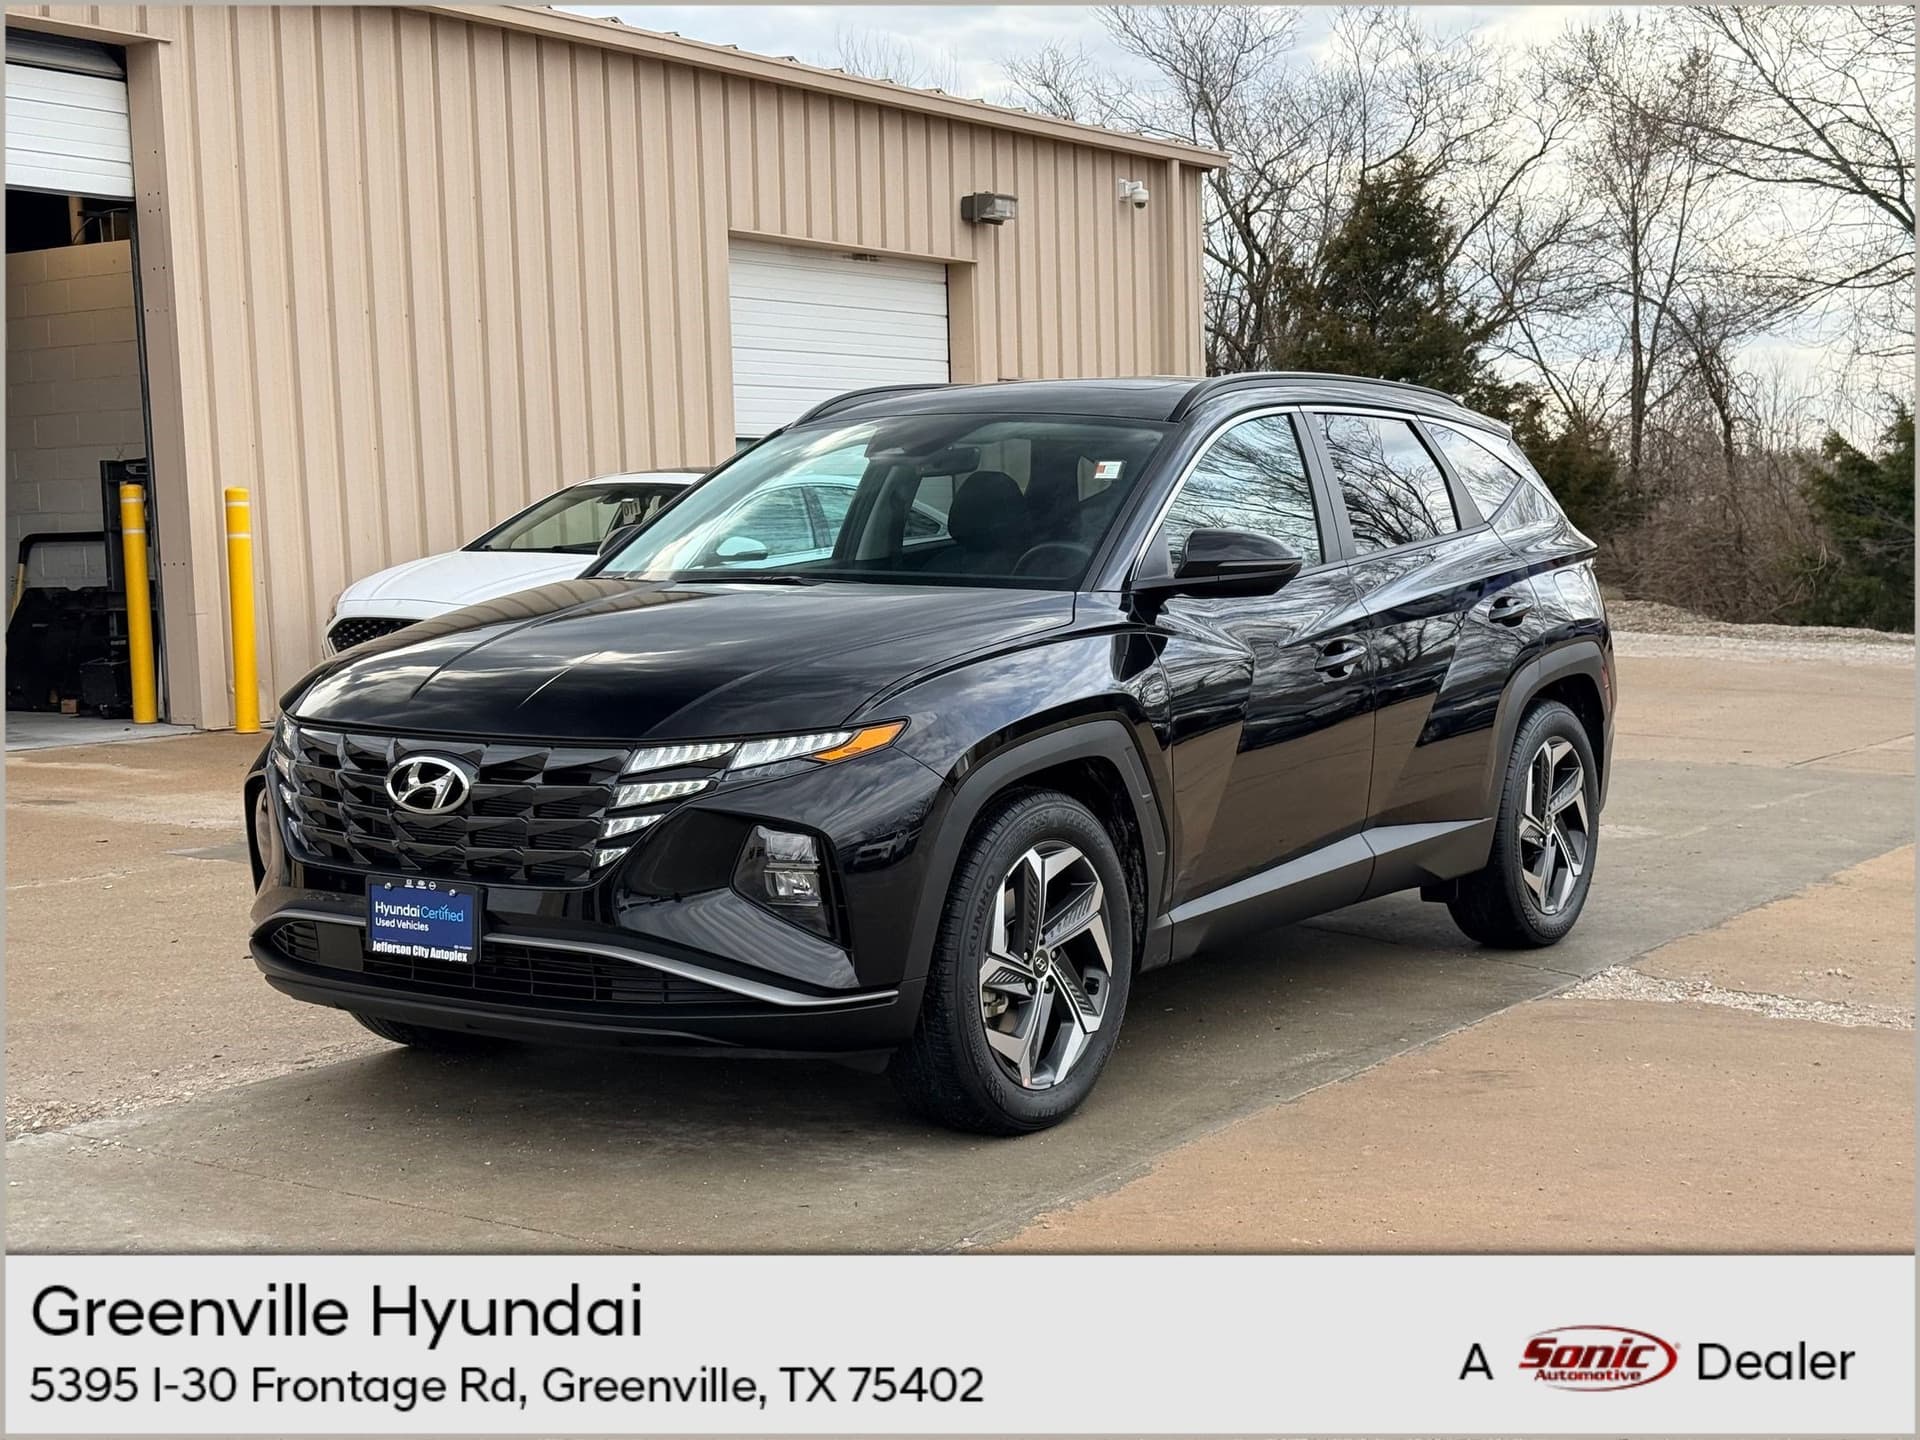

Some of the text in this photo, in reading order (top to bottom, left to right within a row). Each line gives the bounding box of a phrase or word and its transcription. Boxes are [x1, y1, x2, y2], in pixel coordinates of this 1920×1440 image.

[375, 901, 464, 921] Hyundai Certified
[968, 875, 995, 957] KUMHO
[375, 917, 429, 931] Used Vehicles
[372, 940, 468, 962] Jefferson City Autoplex
